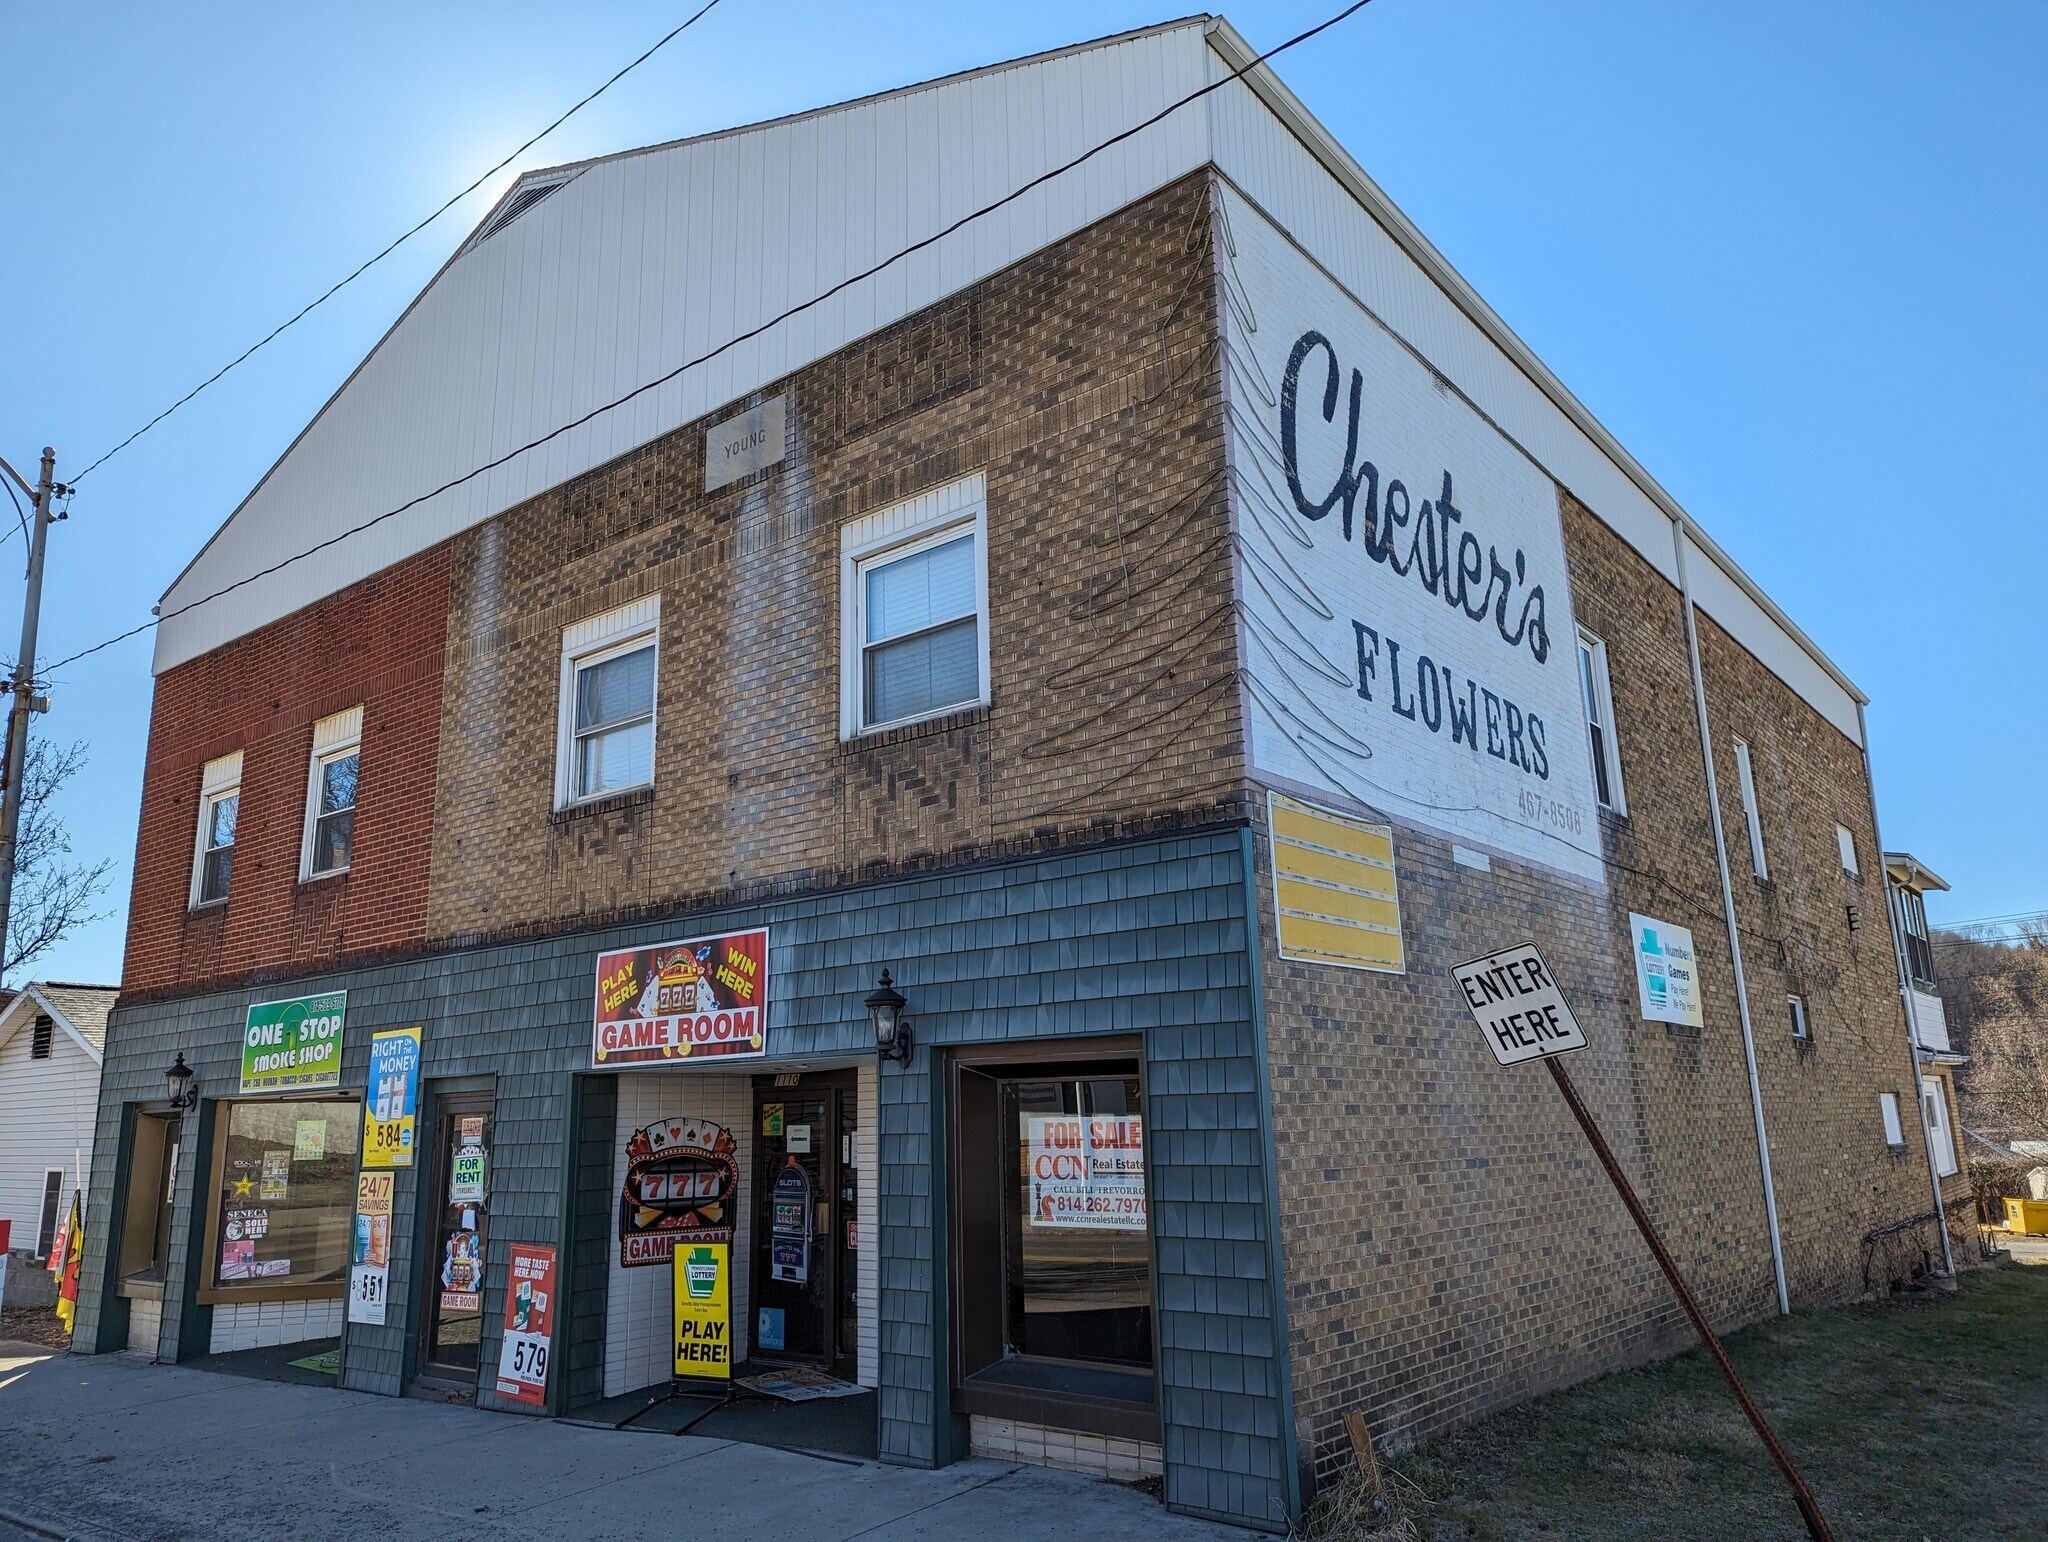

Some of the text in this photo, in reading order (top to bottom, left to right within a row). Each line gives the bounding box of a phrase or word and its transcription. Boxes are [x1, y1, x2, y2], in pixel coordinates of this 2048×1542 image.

[724, 429, 766, 459] YOUNG
[1280, 329, 1550, 665] Chester's
[1351, 618, 1550, 781] FLOWERS
[727, 946, 758, 977] WIN
[601, 960, 635, 995] PLAY
[715, 964, 755, 1001] HERE
[1460, 957, 1552, 1009] ENTER
[1668, 964, 1690, 982] Games
[603, 979, 639, 1014] HERE
[247, 1022, 284, 1048] ONE
[299, 1015, 341, 1042] STOP
[601, 1010, 755, 1050] GAME ROOM
[1489, 1004, 1571, 1052] HERE
[371, 1039, 404, 1058] RIGHT
[403, 1046, 413, 1055] THE
[404, 1038, 413, 1046] ON
[252, 1041, 334, 1074] SMOKE SHOP
[379, 1055, 417, 1074] MONEY
[1044, 1121, 1142, 1150] FOR SALE
[459, 1158, 478, 1170] FOR
[1035, 1154, 1145, 1181] CCN Real Estate
[359, 1176, 391, 1198] 24/7
[455, 1171, 481, 1184] RENT
[645, 1173, 716, 1198] 7 7 7
[779, 1179, 802, 1187] SLOTS
[1053, 1186, 1074, 1194] CALL
[1076, 1186, 1095, 1194] BILL
[227, 1208, 267, 1219] SENECA
[358, 1199, 389, 1211] SAVINGS
[245, 1218, 268, 1228] SOLD
[245, 1226, 268, 1235] HERE
[514, 1256, 550, 1270] MORE TASTE
[691, 1271, 716, 1280] LOTTERY
[442, 1295, 477, 1308] GAME ROOM
[681, 1319, 726, 1340] PLAY
[513, 1341, 547, 1378] 5.79
[676, 1341, 728, 1364] HERE!
